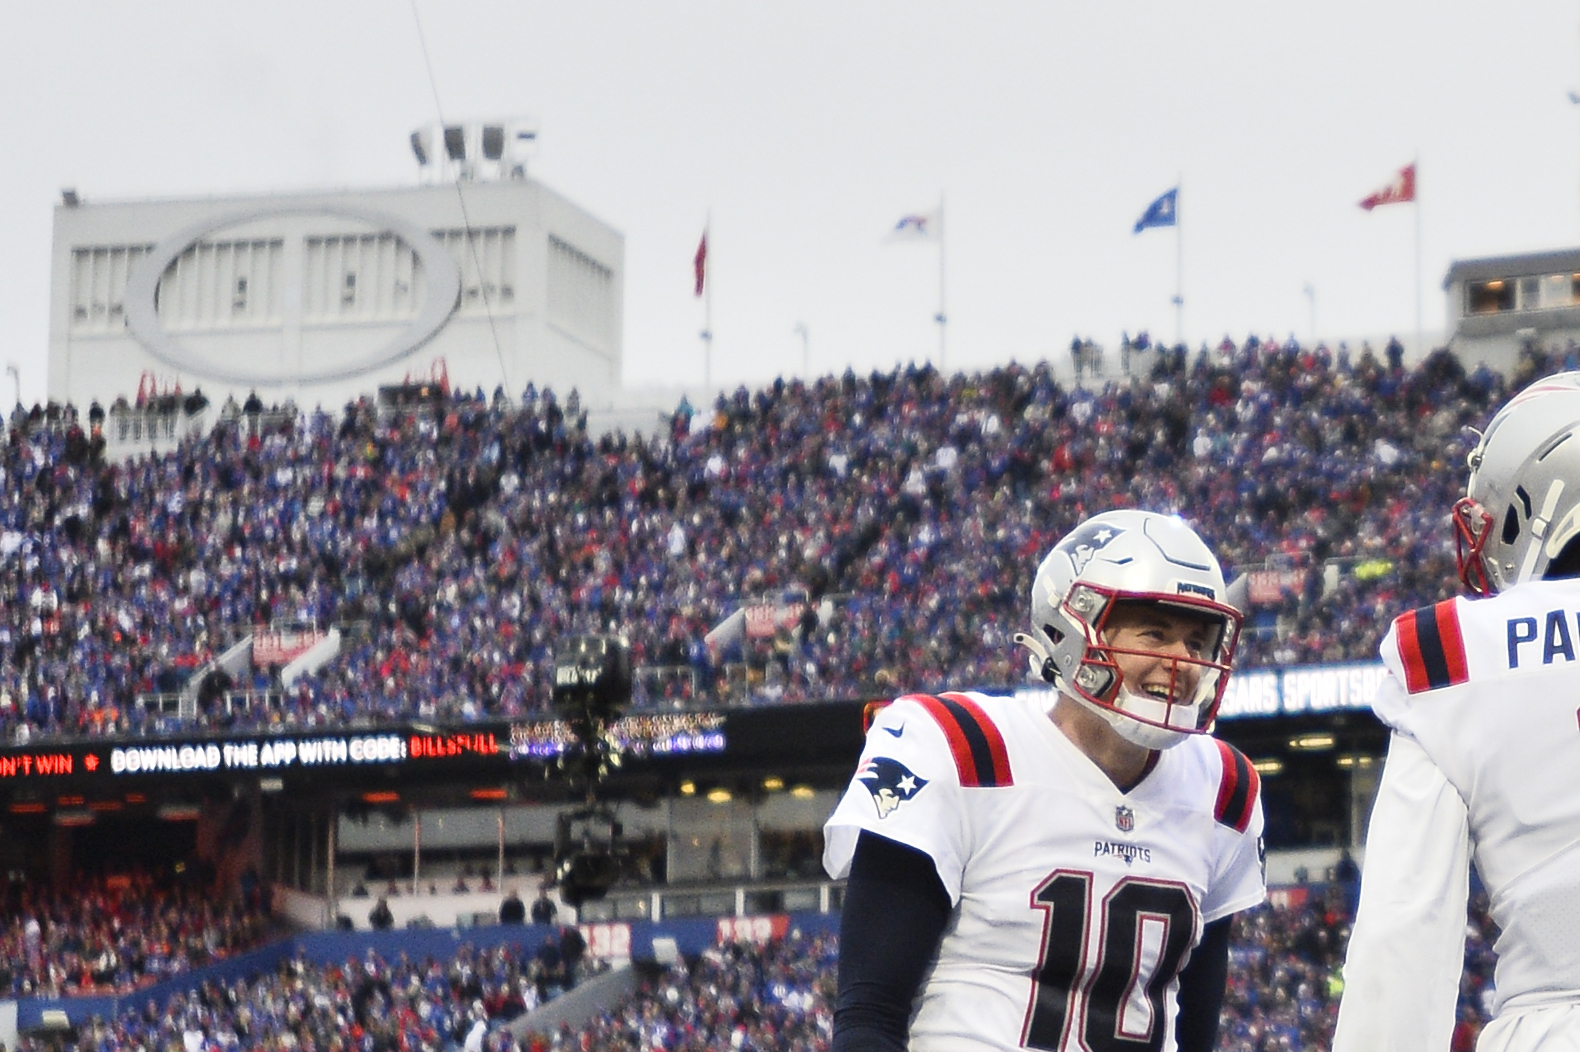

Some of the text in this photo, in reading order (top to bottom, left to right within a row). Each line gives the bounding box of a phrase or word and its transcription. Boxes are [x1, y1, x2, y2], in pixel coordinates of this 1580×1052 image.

[35, 754, 73, 775] WIN
[111, 742, 220, 774] DOWNLOAD
[223, 741, 258, 769] THE
[260, 740, 297, 767] APP
[299, 737, 347, 766] WITH
[1094, 841, 1151, 863] PATRIOTS
